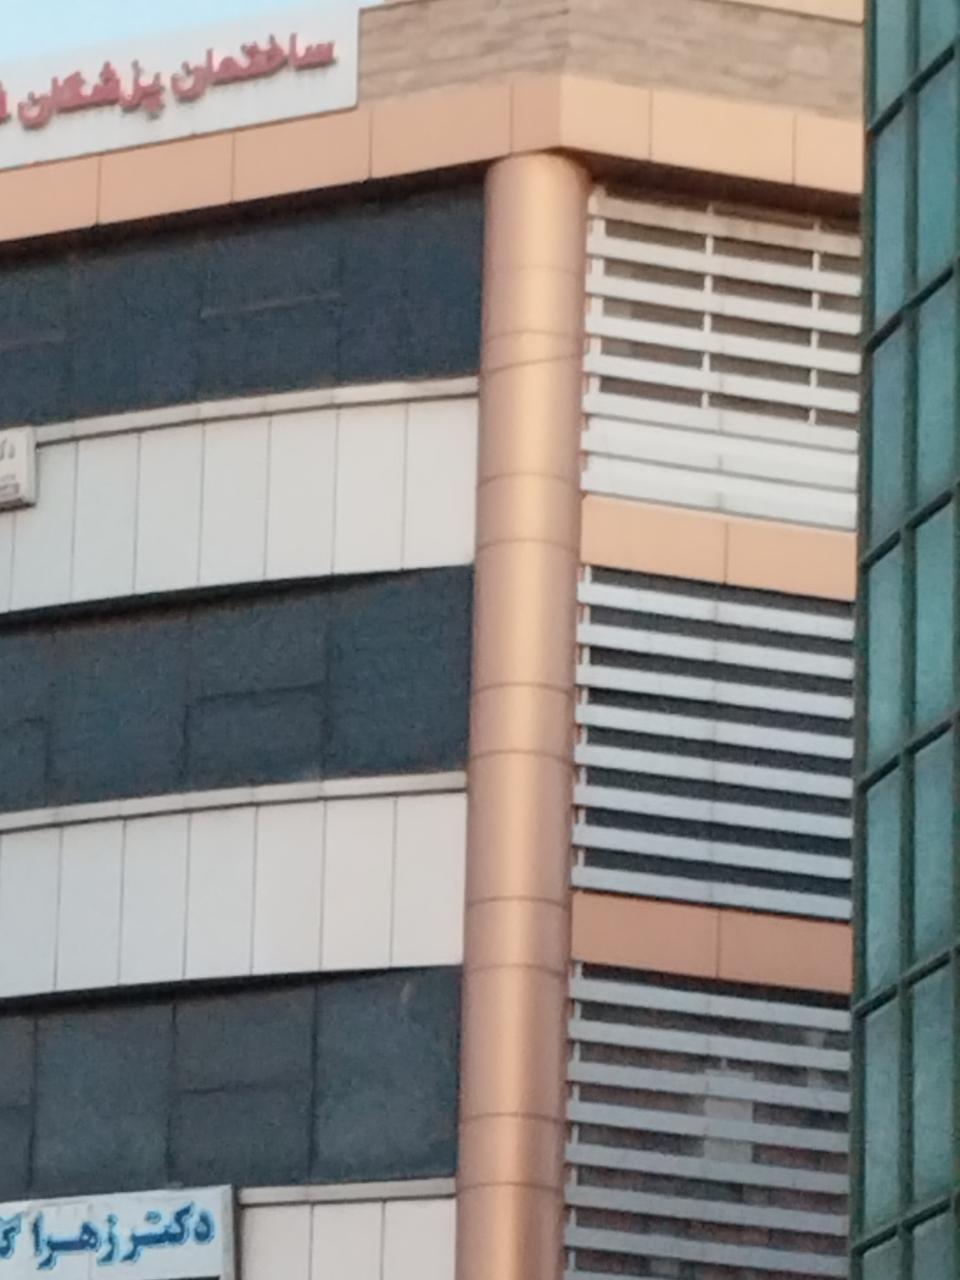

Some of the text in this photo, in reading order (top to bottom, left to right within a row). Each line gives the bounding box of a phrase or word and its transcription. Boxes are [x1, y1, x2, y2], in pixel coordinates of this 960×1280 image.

[17, 61, 165, 129] پزشکان
[170, 33, 337, 101] ساختمان
[31, 1210, 121, 1271] زهرا
[121, 1199, 217, 1263] دکتر
